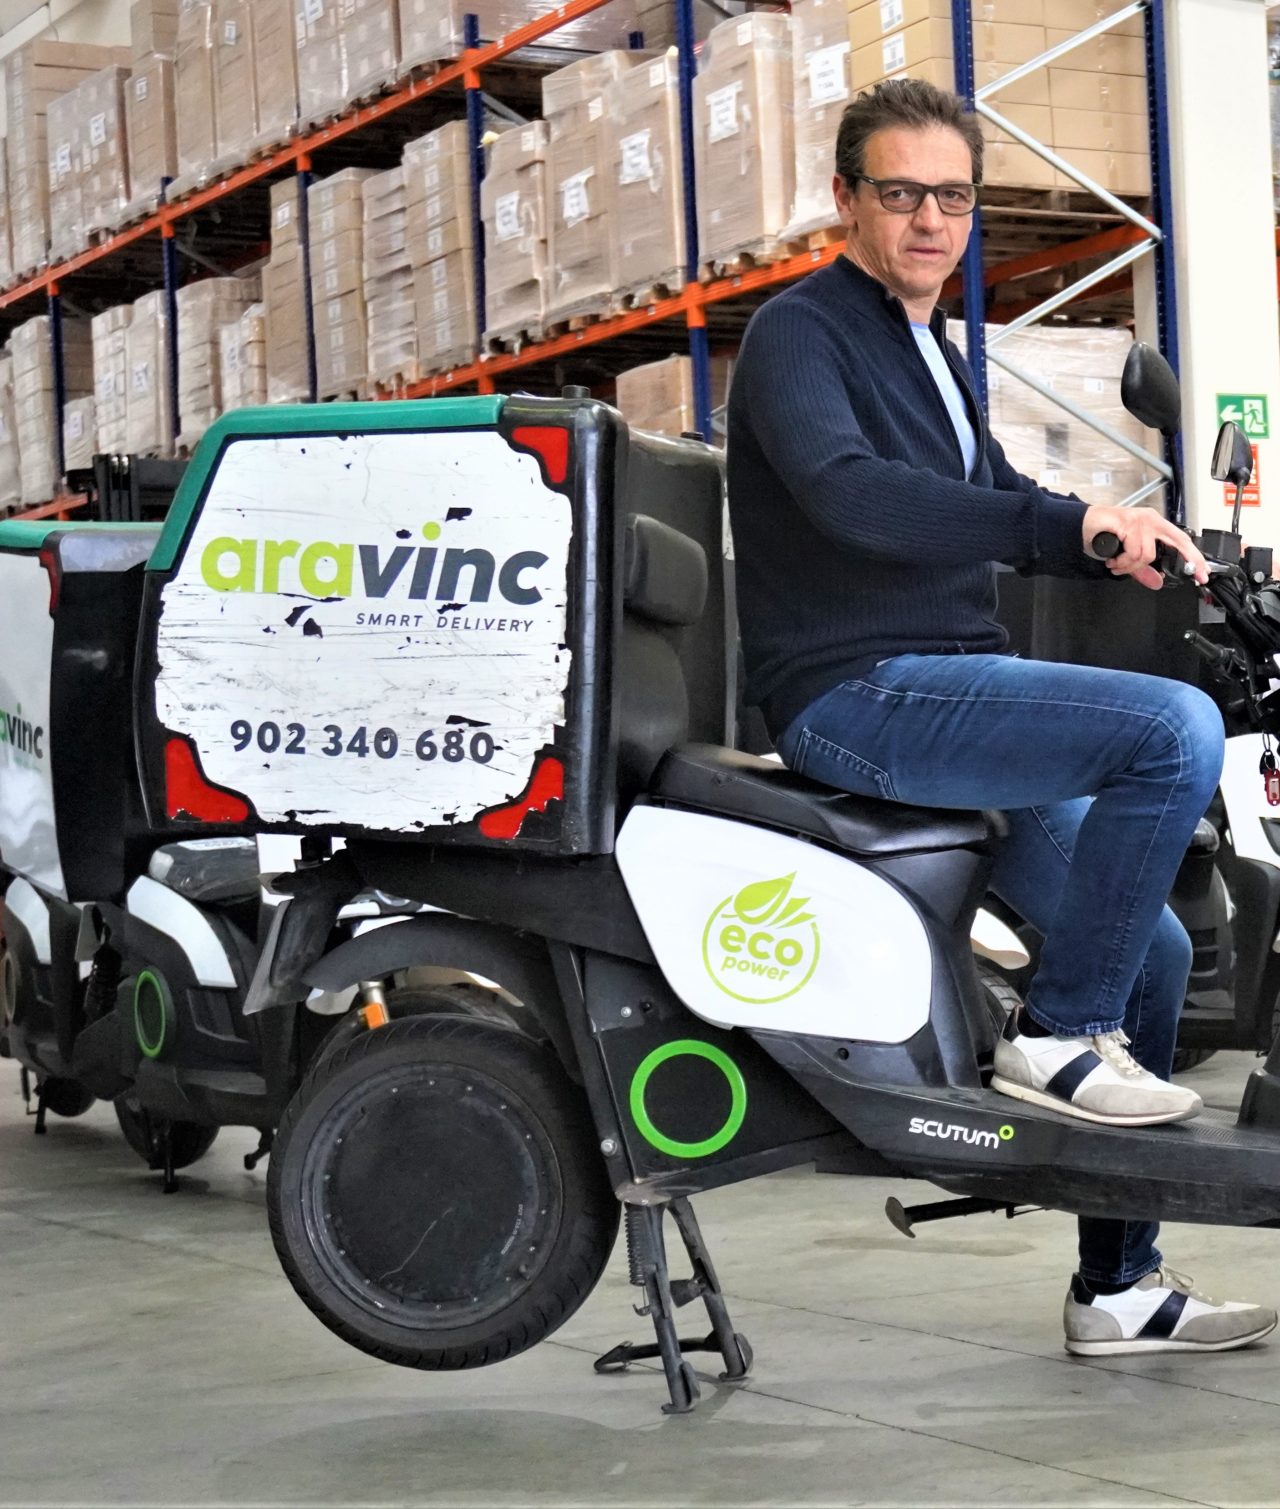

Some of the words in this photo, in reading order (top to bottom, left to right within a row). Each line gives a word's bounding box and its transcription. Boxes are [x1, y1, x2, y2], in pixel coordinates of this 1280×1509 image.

[200, 521, 550, 605] aravinc
[356, 612, 424, 628] SMART
[436, 616, 534, 633] DELIVERY
[230, 719, 306, 755] 902
[321, 724, 399, 760] 340
[415, 730, 495, 764] 680
[719, 924, 804, 967] eco
[720, 955, 790, 981] power
